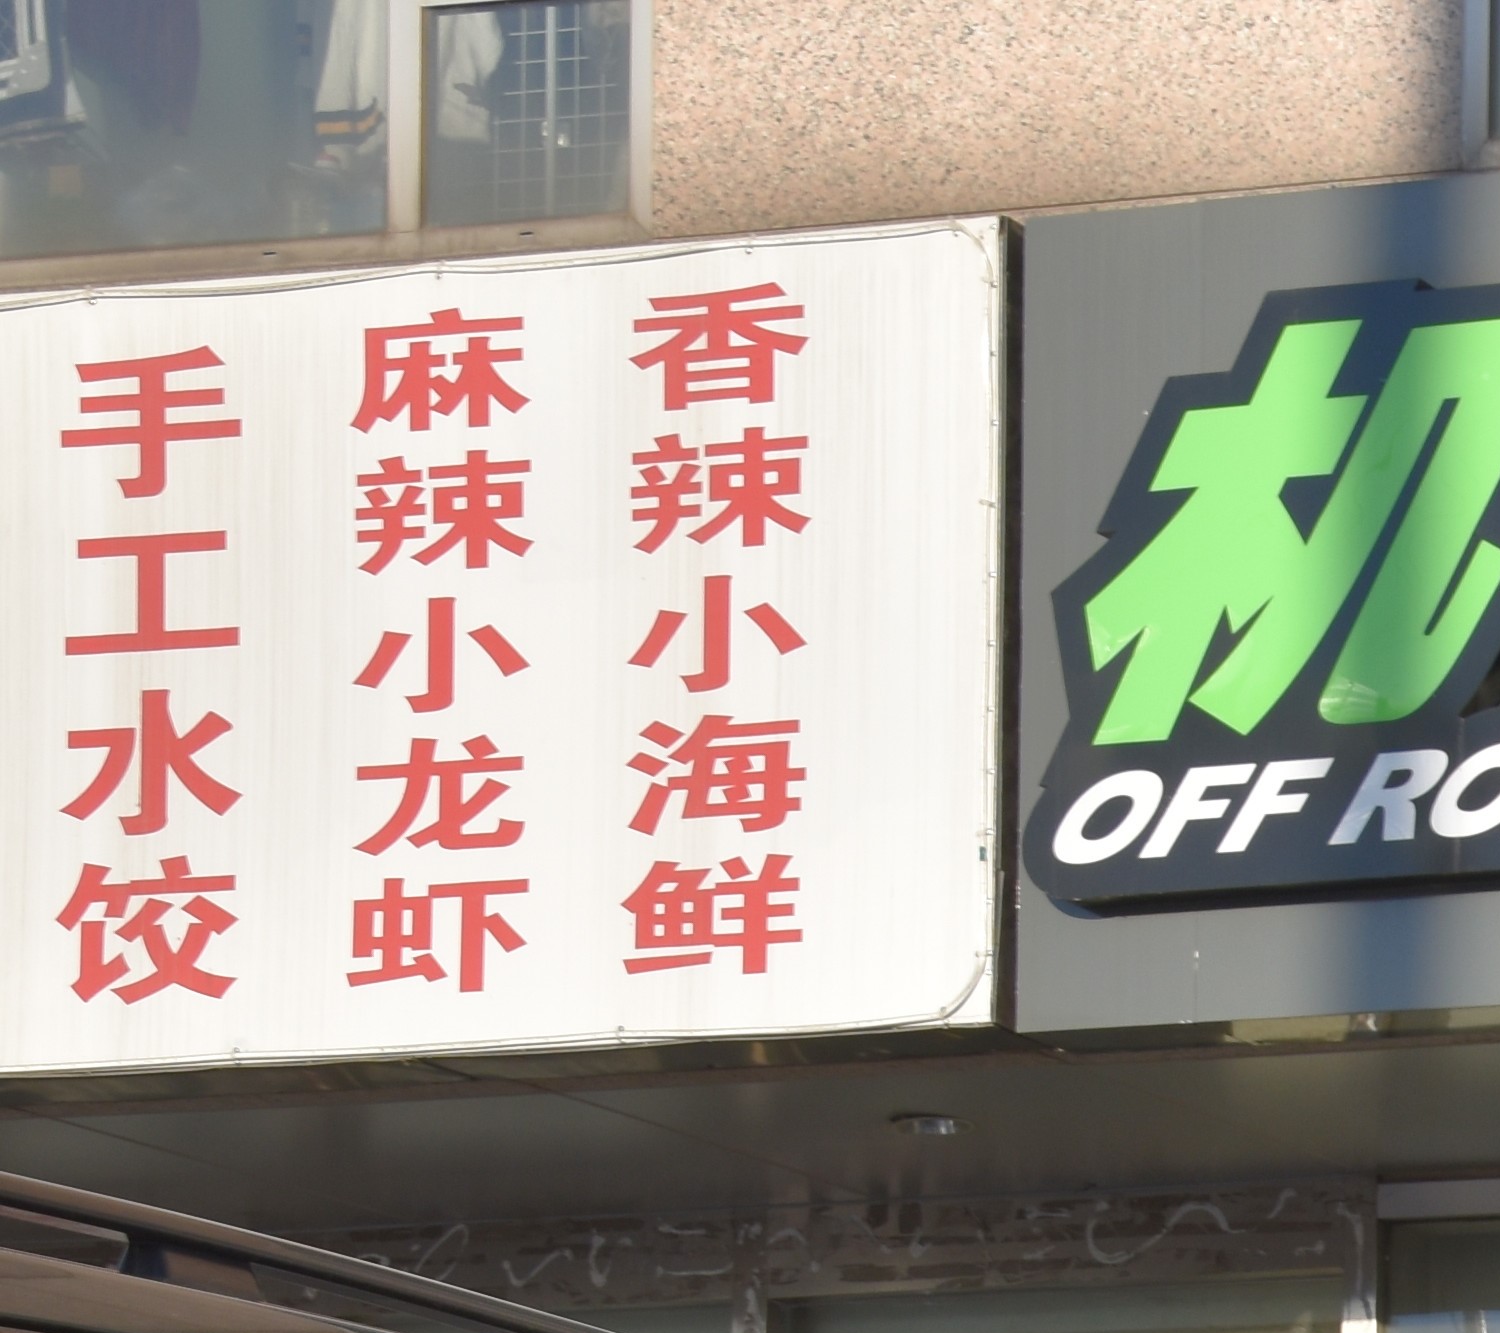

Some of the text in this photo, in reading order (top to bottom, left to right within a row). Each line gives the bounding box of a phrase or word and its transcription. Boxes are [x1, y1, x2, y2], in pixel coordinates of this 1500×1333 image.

[57, 346, 242, 1005] 手工水饺
[347, 308, 531, 993] 麻辣小龙虾
[623, 282, 809, 975] 香辣小海鲜
[1052, 757, 1334, 865] OFF
